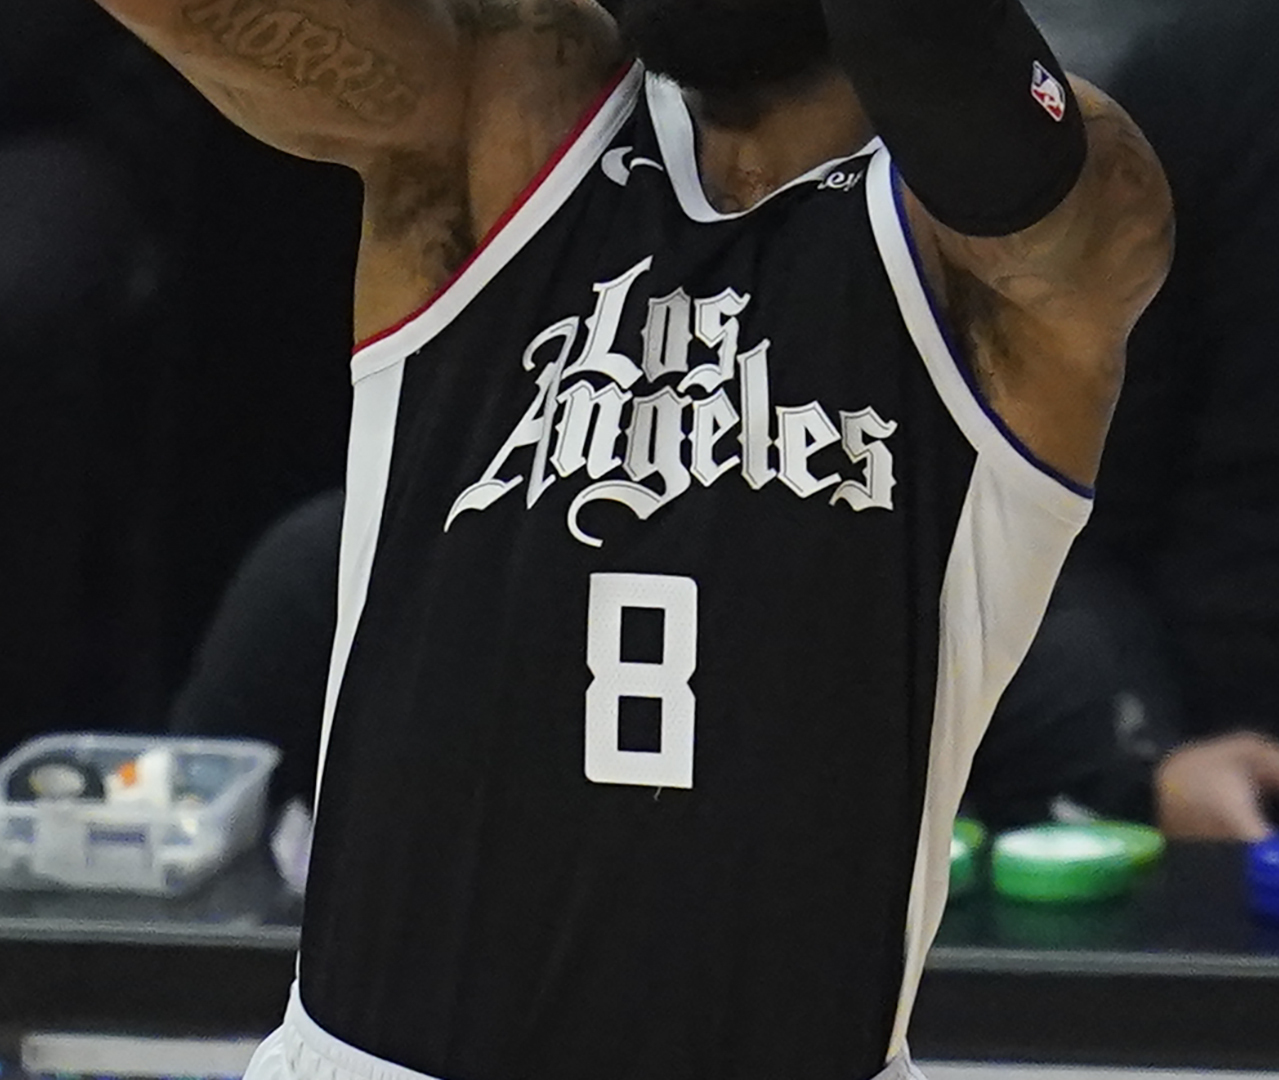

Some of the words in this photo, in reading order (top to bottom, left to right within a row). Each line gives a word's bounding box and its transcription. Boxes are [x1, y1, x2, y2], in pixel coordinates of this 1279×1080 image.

[443, 314, 898, 548] Angeles
[562, 255, 751, 394] Los
[584, 571, 698, 789] 8
